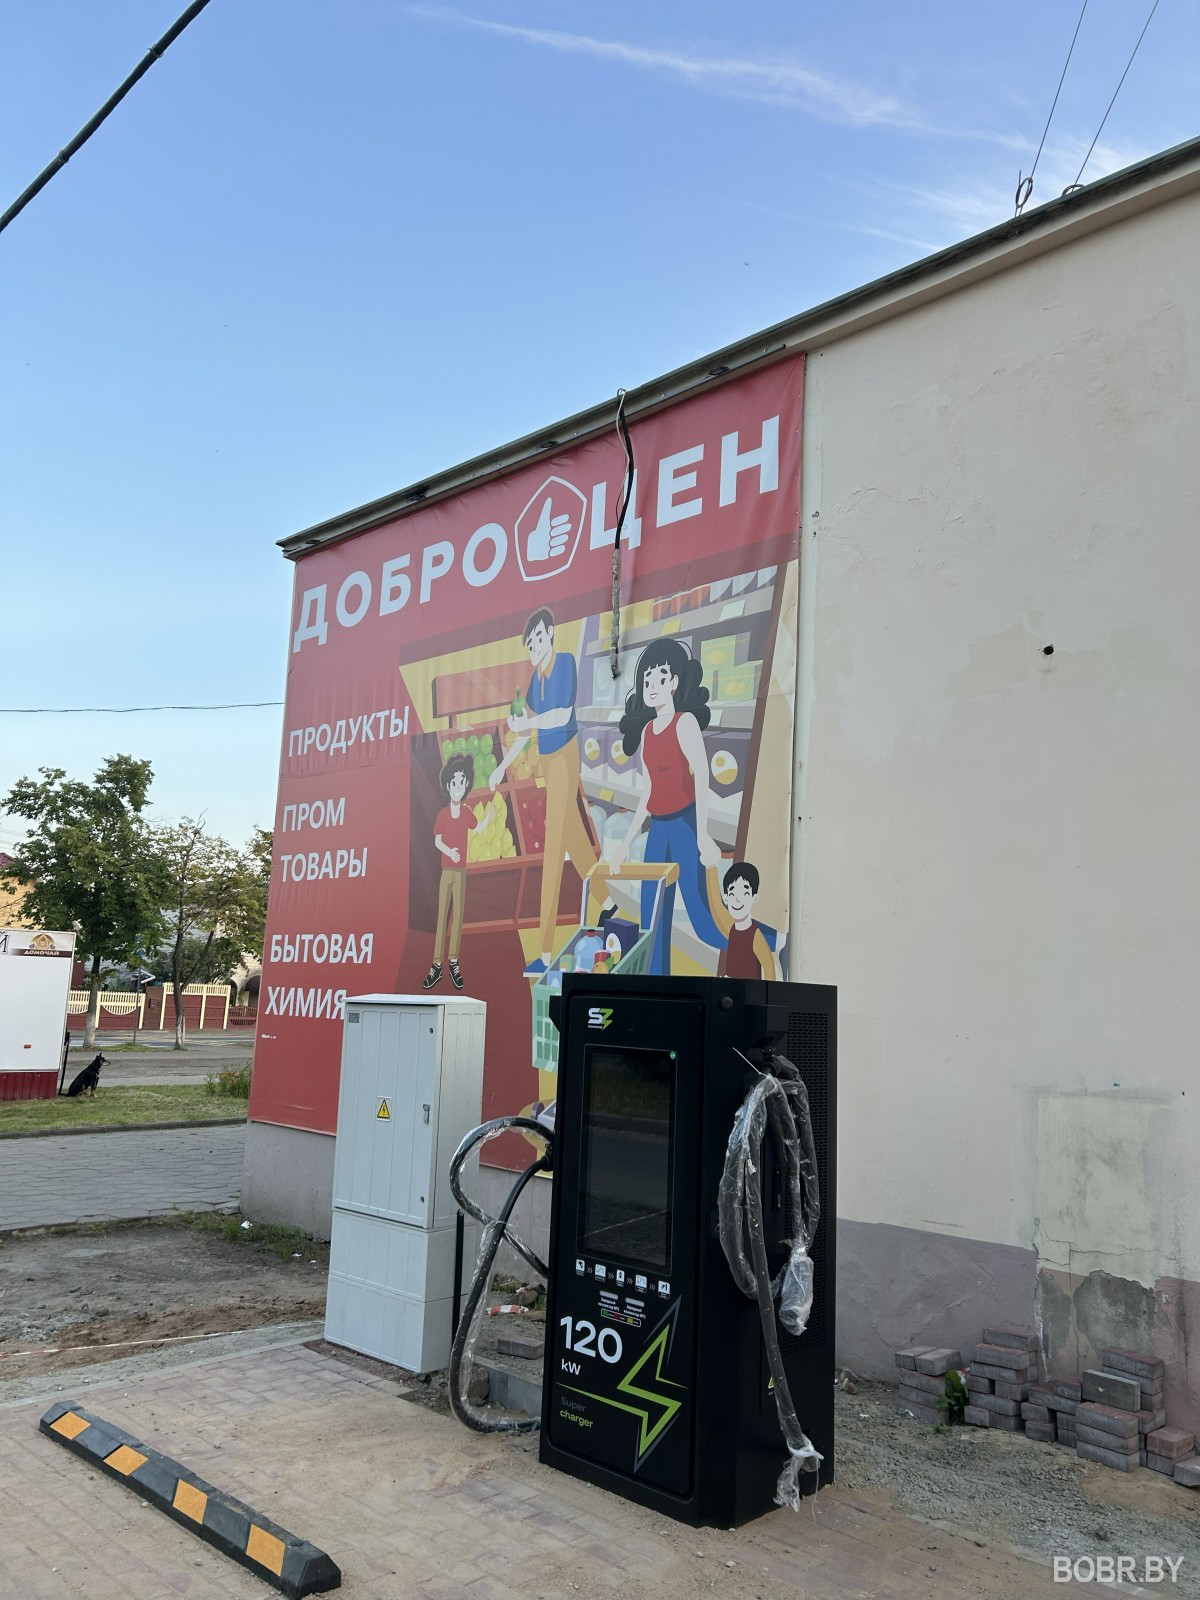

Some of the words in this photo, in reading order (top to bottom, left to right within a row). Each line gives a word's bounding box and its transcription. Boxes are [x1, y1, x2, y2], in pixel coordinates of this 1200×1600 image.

[293, 522, 508, 654] ДОБРО
[589, 414, 780, 550] ЦЕН
[288, 705, 410, 758] ПРОДУКТЫ
[282, 797, 346, 833] ПРОМ
[280, 847, 368, 882] ТОВАРЫ
[270, 932, 374, 964] БЫТОВАЯ
[265, 986, 347, 1020] ХИМИЯ
[560, 1315, 623, 1364] 120
[561, 1358, 581, 1375] kW
[559, 1409, 594, 1428] charger
[561, 1396, 587, 1413] Super
